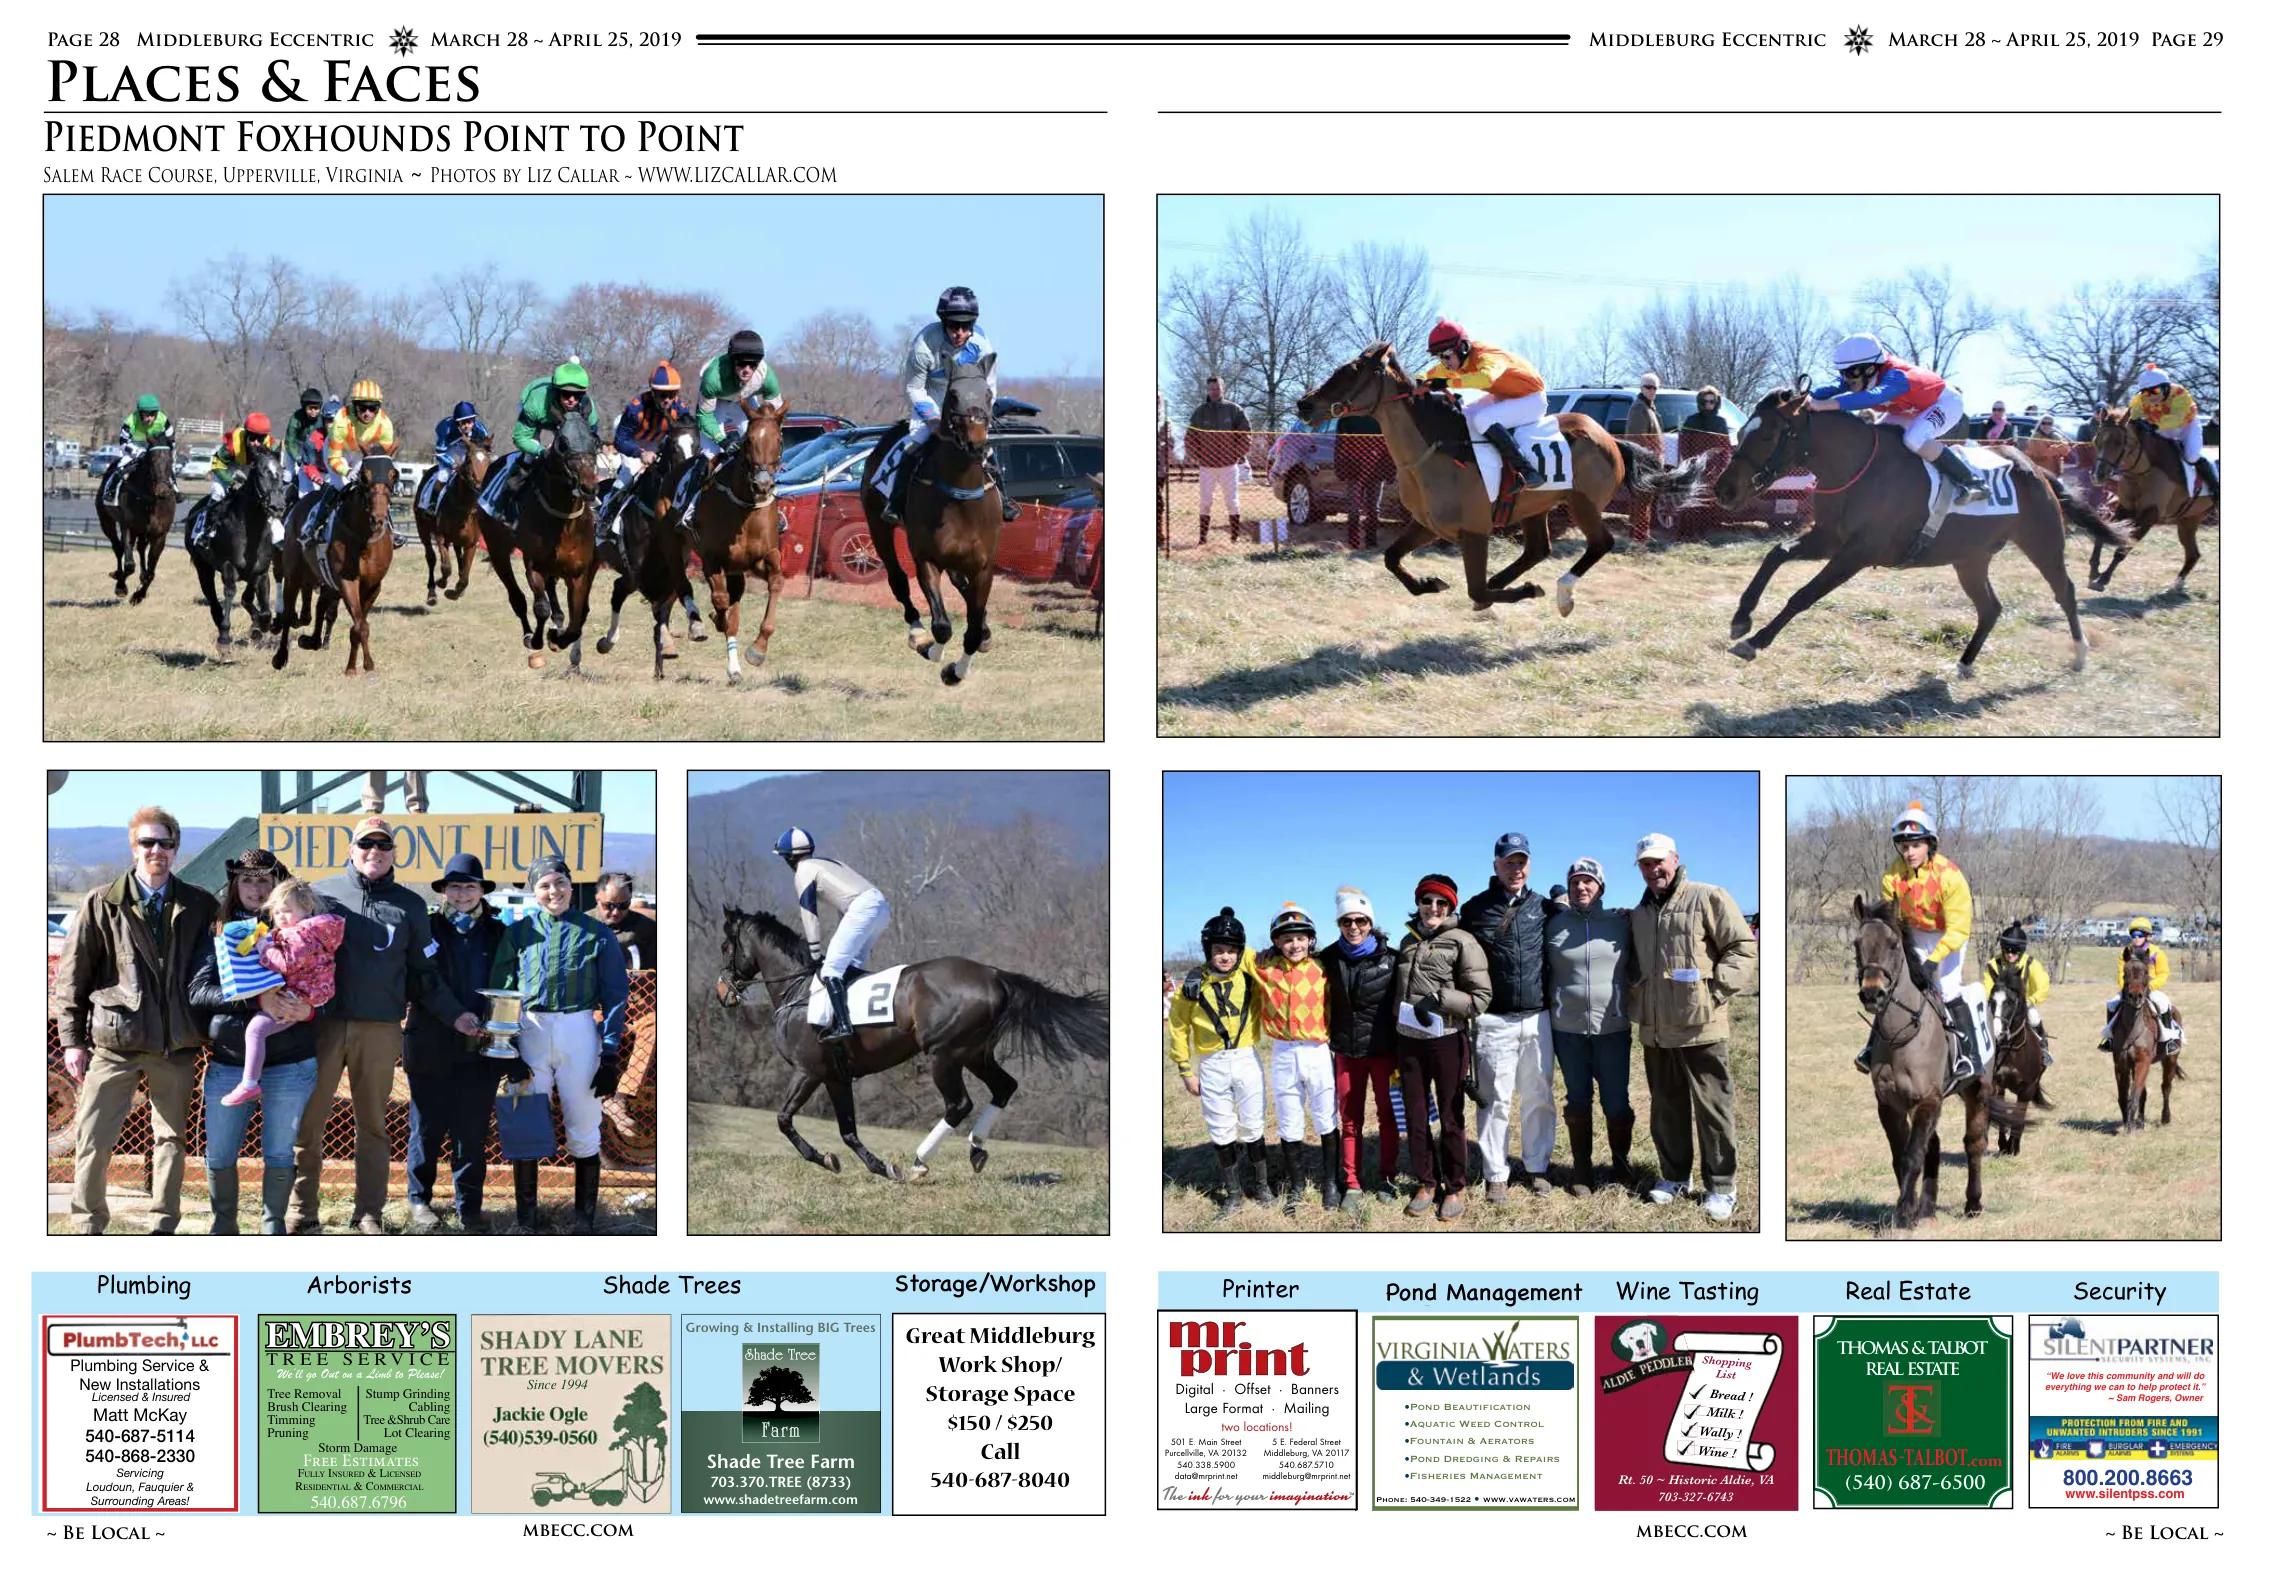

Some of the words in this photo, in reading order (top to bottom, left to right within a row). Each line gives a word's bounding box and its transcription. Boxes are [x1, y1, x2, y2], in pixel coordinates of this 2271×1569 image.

[48, 32, 92, 46] PAGE
[99, 32, 119, 47] 28
[137, 32, 262, 46] MIDDLEBURG
[270, 32, 373, 46] ECCENTRIC
[431, 32, 500, 46] MARCH
[507, 32, 528, 46] 28
[548, 32, 602, 46] APRIL
[608, 32, 632, 48] 25,
[639, 32, 681, 46] 2019
[1590, 32, 1714, 46] MIDDLEBURG
[1722, 32, 1826, 46] ECCENTRIC
[1889, 32, 1957, 46] MARCH
[1965, 32, 1985, 46] 28
[2006, 32, 2059, 46] APRIL
[2066, 32, 2090, 48] 25,
[2097, 32, 2139, 46] 2019
[2152, 32, 2196, 46] PAGE
[2203, 32, 2223, 46] 29
[48, 60, 239, 102] PLACES
[262, 59, 308, 102] &
[324, 60, 479, 102] FACES
[45, 121, 225, 152] PIEDMONT
[237, 121, 450, 152] FOXHOUNDS
[464, 121, 569, 152] POINT
[580, 125, 625, 152] TO
[638, 121, 744, 152] POINT
[44, 167, 94, 183] SALEM
[102, 167, 142, 182] RACE
[149, 167, 216, 183] COURSE,
[224, 167, 319, 183] UPPERVILLE,
[326, 167, 403, 182] VIRGINIA
[431, 167, 495, 182] PHOTOS
[504, 169, 521, 182] BY
[528, 167, 551, 182] LIZ
[558, 167, 620, 183] CALLAR
[638, 167, 837, 183] WWW.LIZCALLAR.COM
[1532, 442, 1566, 483] 11
[267, 825, 469, 869] PIEDONT
[485, 824, 594, 871] HUNT
[867, 983, 891, 1016] 2
[1213, 981, 1234, 1017] K
[98, 1274, 190, 1300] Plumbing
[307, 1275, 411, 1294] Arborists
[604, 1274, 670, 1294] Shade
[678, 1276, 740, 1294] Trees
[896, 1273, 1095, 1298] Storage/Workshop
[1223, 1279, 1299, 1298] Printer
[1847, 1280, 1890, 1300] Real
[1900, 1280, 1971, 1300] Estate
[1386, 1283, 1436, 1301] Pond
[1447, 1283, 1583, 1307] Management
[1616, 1281, 1671, 1300] Wine
[1679, 1281, 1758, 1306] Tasting
[2074, 1282, 2166, 1306] Security
[63, 1332, 186, 1351] PlumbTech,
[192, 1336, 218, 1347] LLC
[481, 1331, 566, 1350] SHADY
[575, 1330, 643, 1348] LANE
[906, 1328, 965, 1343] Great
[970, 1327, 1095, 1348] Middleburg
[1170, 1320, 1246, 1348] mr
[1376, 1342, 1481, 1360] VIRGINIA
[1481, 1321, 1570, 1360] WATERS
[745, 1346, 783, 1361] Shade
[788, 1348, 817, 1361] Tree
[1837, 1341, 1908, 1354] THOMAS
[1912, 1341, 1926, 1354] &
[1928, 1341, 1988, 1354] TALBOT
[2044, 1338, 2213, 1355] SILENTPARTNER
[71, 1359, 137, 1375] Plumbing
[142, 1359, 194, 1371] Service
[199, 1359, 209, 1371] &
[266, 1353, 328, 1365] TREE
[343, 1353, 449, 1365] SERVICE
[481, 1357, 548, 1376] TREE
[556, 1356, 663, 1374] MOVERS
[939, 1356, 997, 1372] Work
[1002, 1356, 1062, 1377] Shop/
[1180, 1341, 1310, 1377] print
[1702, 1356, 1752, 1369] Shopping
[1407, 1369, 1424, 1387] &
[1434, 1366, 1541, 1386] Wetlands
[1602, 1369, 1636, 1390] ALDIE
[1639, 1355, 1693, 1376] PEDDLER
[1715, 1370, 1736, 1379] List
[1867, 1362, 1904, 1375] REAL
[1908, 1362, 1959, 1375] ESTATE
[80, 1378, 111, 1390] New
[117, 1378, 200, 1390] Installations
[527, 1380, 556, 1389] Since
[562, 1379, 588, 1389] 1994
[1176, 1383, 1213, 1398] Digital
[1235, 1382, 1271, 1394] Offset
[1292, 1384, 1339, 1394] Banners
[267, 1389, 290, 1398] Tree
[295, 1389, 341, 1398] Removal
[926, 1386, 1008, 1406] Storage
[1014, 1386, 1075, 1406] Space
[1709, 1389, 1745, 1401] Bread
[94, 1408, 128, 1421] Matt
[134, 1408, 187, 1425] McKay
[493, 1407, 544, 1423] Jackie
[550, 1407, 587, 1424] Ogle
[1186, 1403, 1217, 1417] Large
[1223, 1403, 1263, 1413] Format
[1284, 1402, 1329, 1417] Mailing
[1706, 1407, 1735, 1419] Milk
[267, 1415, 315, 1427] Timming
[948, 1414, 990, 1431] $150
[996, 1415, 1002, 1430] /
[1008, 1415, 1052, 1431] $250
[86, 1429, 195, 1442] 540-687-5114
[484, 1430, 597, 1445] (540)539-0560
[762, 1420, 801, 1440] Farm
[1700, 1426, 1733, 1441] Wally
[86, 1449, 195, 1462] 540-868-2330
[981, 1443, 1020, 1459] Call
[1699, 1446, 1728, 1458] Wine
[1826, 1448, 2002, 1466] THOMAS-TALBOT.com
[708, 1454, 760, 1468] Shade
[767, 1455, 804, 1468] Tree
[812, 1455, 854, 1468] Farm
[711, 1477, 801, 1487] 703.370.TREE
[807, 1476, 850, 1490] (8733)
[931, 1472, 1069, 1487] 540-687-8040
[1175, 1472, 1238, 1481] data@mrprint.net
[1618, 1475, 1635, 1484] Rt.
[1640, 1476, 1653, 1484] 50
[1669, 1475, 1717, 1484] Historic
[1720, 1475, 1754, 1486] Aldie,
[1761, 1475, 1774, 1484] VA
[1846, 1475, 1892, 1491] (540)
[1899, 1475, 1985, 1489] 687-6500
[2063, 1470, 2192, 1486] 800.200.8663
[312, 1496, 406, 1508] 540.687.6796
[704, 1494, 857, 1504] www.shadetreefarm.com
[1659, 1492, 1733, 1501] 703-327-6743
[2065, 1489, 2184, 1501] www.silentpss.com
[64, 1525, 84, 1539] BE
[92, 1525, 150, 1539] LOCAL
[523, 1524, 634, 1536] MBECC.COM
[1637, 1525, 1747, 1537] MBECC.COM
[2122, 1525, 2143, 1539] BE
[2150, 1525, 2208, 1539] LOCAL
